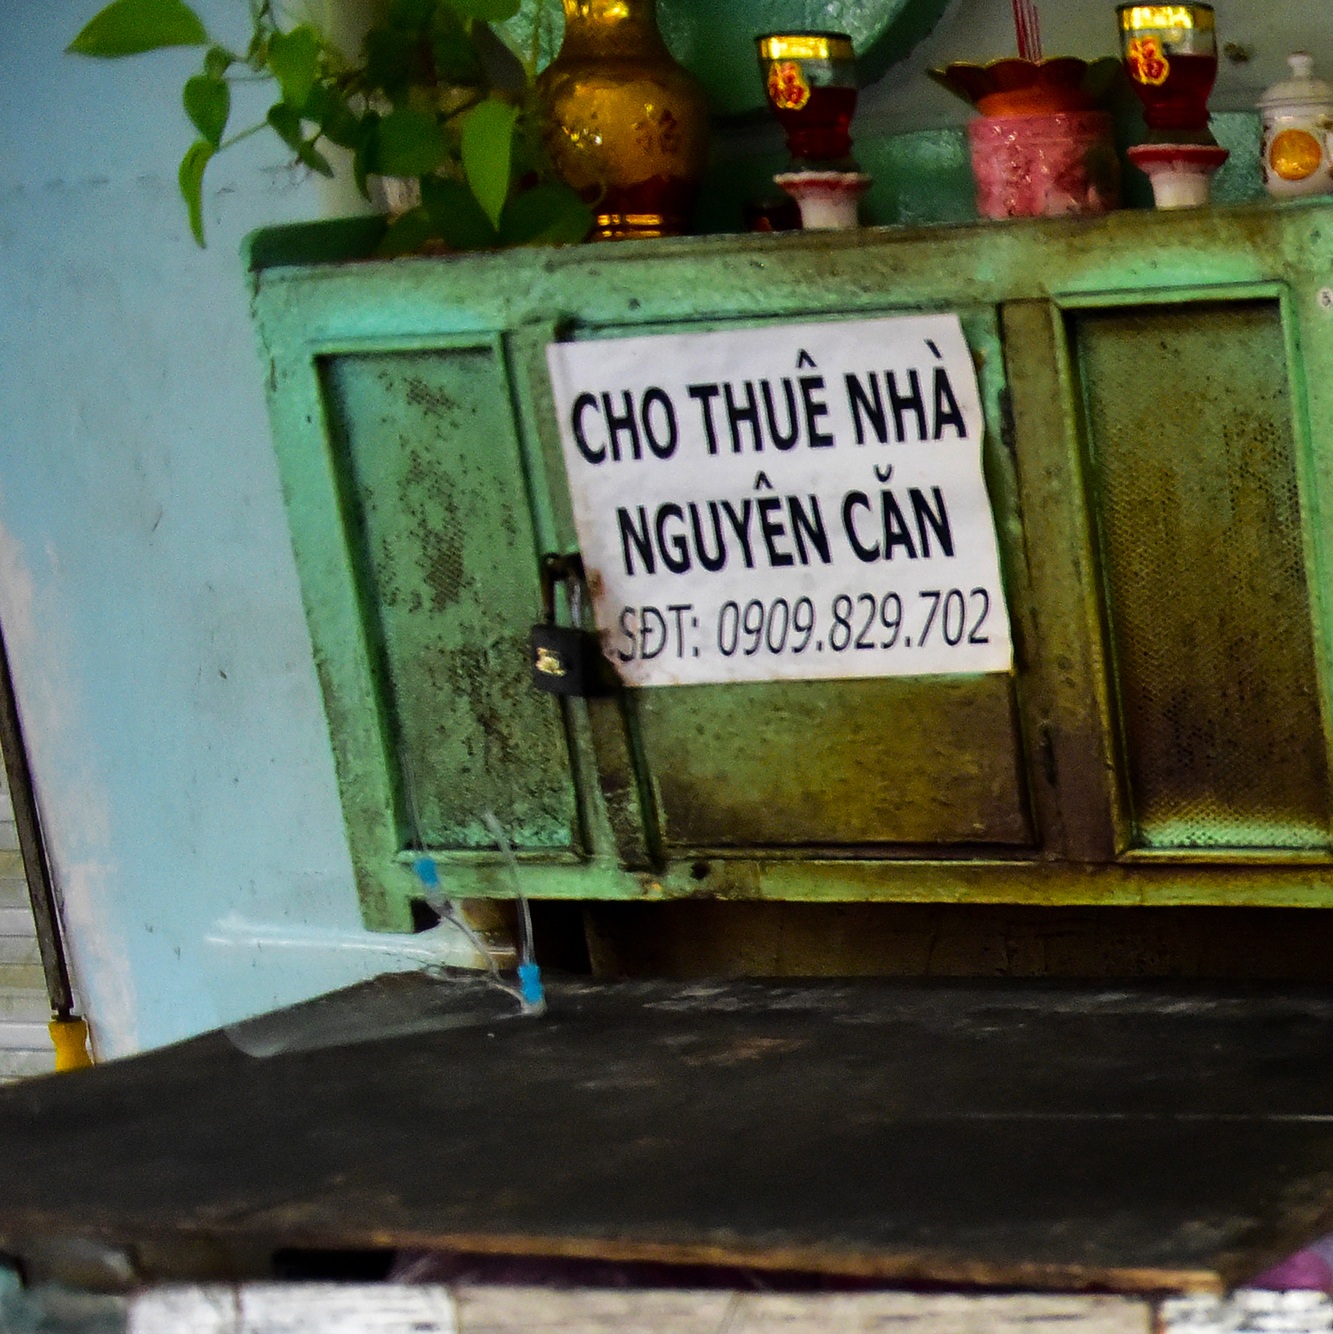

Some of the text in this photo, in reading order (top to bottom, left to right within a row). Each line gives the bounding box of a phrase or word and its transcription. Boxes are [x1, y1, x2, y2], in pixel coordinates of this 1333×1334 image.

[571, 340, 968, 465] CHO THUÊ NHÀ
[616, 464, 954, 578] NGUYÊN CĂN
[617, 587, 991, 664] SĐT: 0909.829.702
